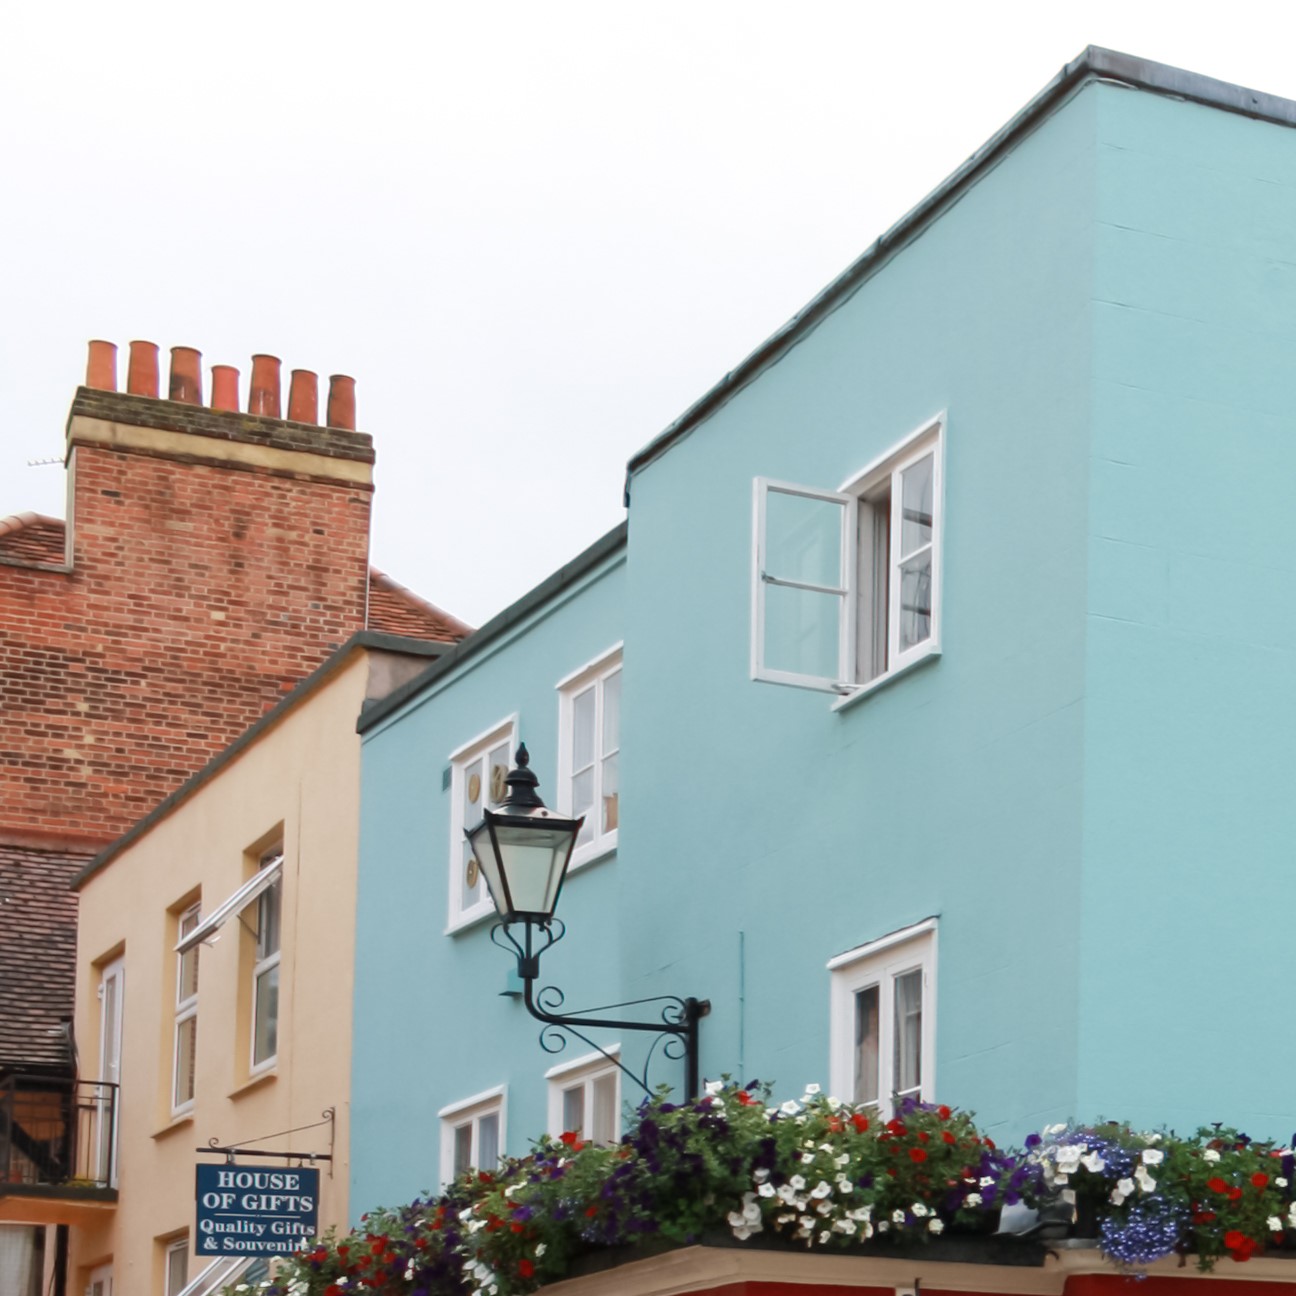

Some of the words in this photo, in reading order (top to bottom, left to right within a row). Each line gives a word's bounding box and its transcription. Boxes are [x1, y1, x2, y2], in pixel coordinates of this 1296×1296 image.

[217, 1171, 300, 1191] HOUSE
[202, 1192, 236, 1209] OF
[241, 1194, 314, 1212] GIFTS
[200, 1219, 267, 1237] Quality
[271, 1221, 316, 1236] Gifts
[203, 1236, 219, 1251] &
